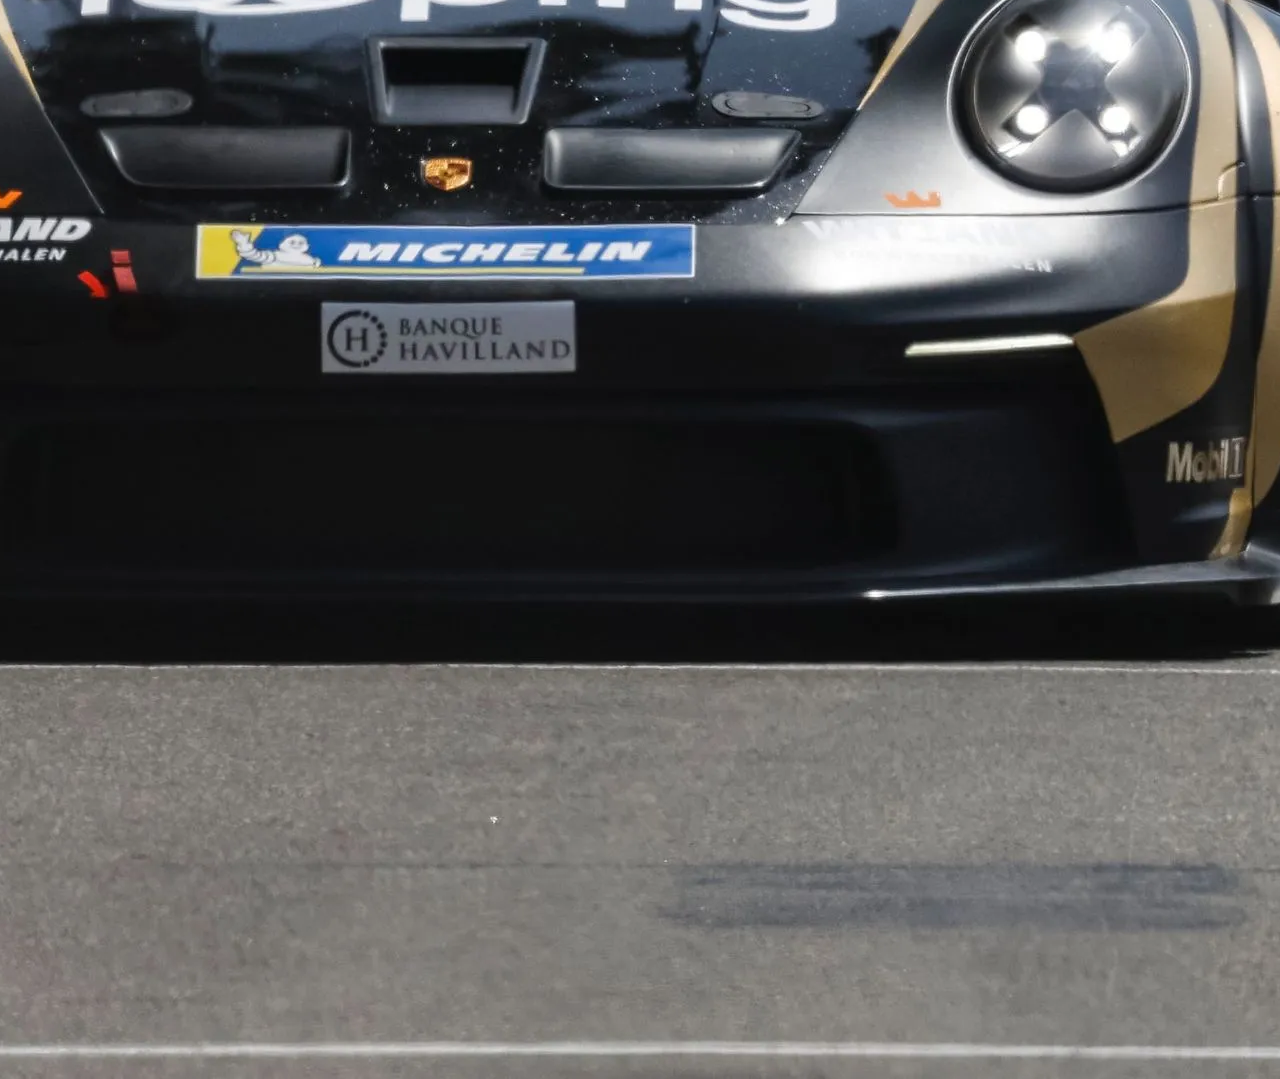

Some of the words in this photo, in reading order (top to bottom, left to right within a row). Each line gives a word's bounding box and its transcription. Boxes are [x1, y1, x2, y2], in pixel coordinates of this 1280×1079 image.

[337, 240, 652, 263] MICHELIN
[399, 316, 503, 340] BANQUE
[399, 340, 571, 362] HAVILLAND
